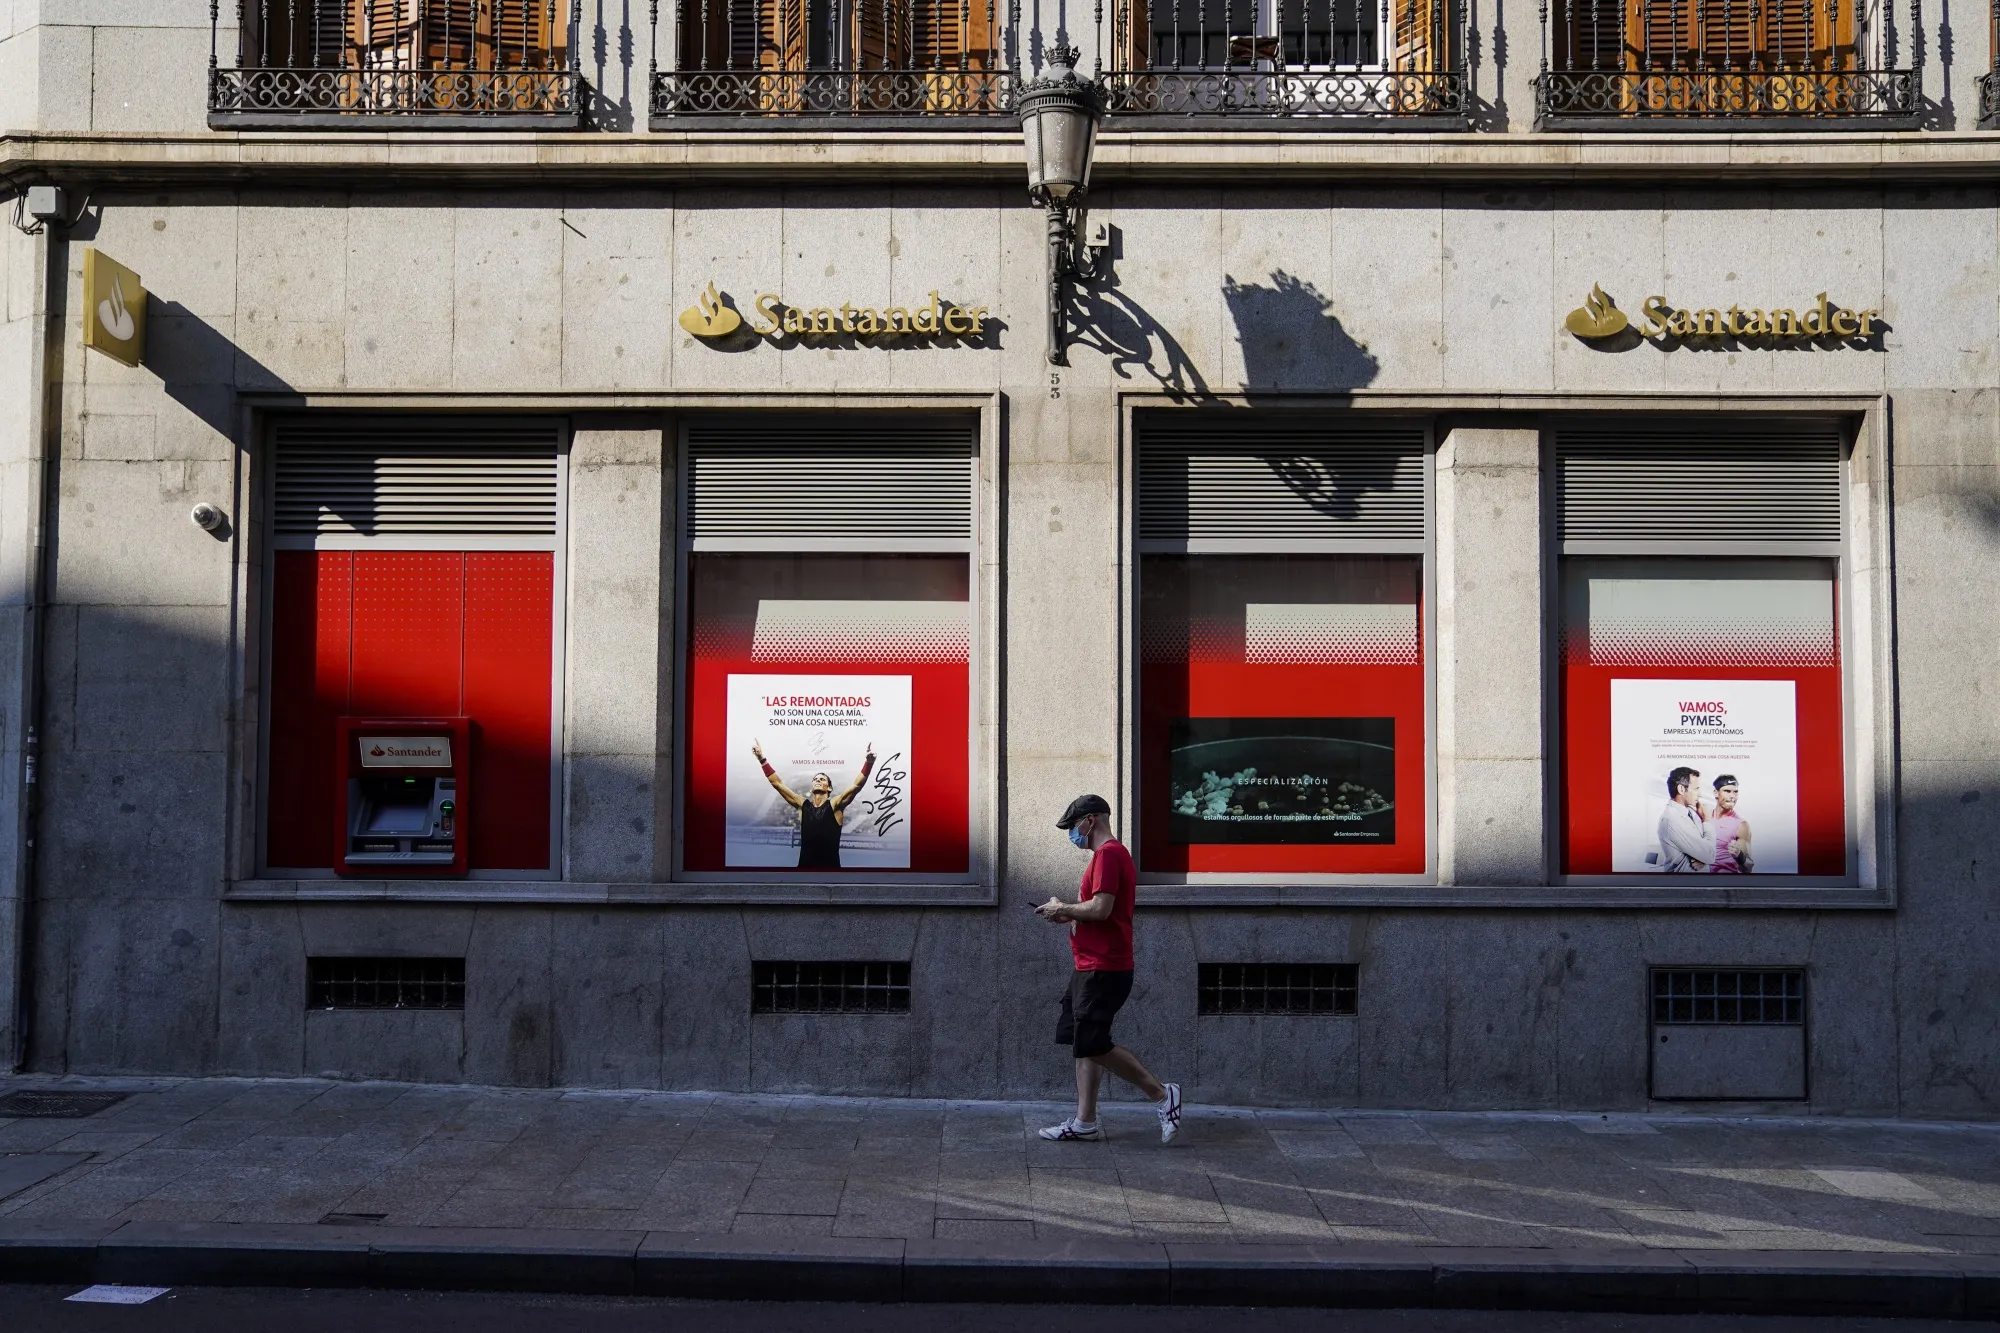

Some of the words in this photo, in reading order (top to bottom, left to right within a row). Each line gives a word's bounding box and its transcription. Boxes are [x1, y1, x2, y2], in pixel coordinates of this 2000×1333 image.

[754, 289, 989, 334] Santander
[1640, 291, 1880, 337] Santander
[789, 696, 871, 708] REMONTADAS
[773, 709, 786, 717] NO
[787, 709, 804, 717] SON
[805, 709, 822, 717] UNA
[823, 709, 845, 717] COSA
[845, 707, 864, 717] MÍA.
[1678, 701, 1728, 715] VAMOS,
[769, 718, 786, 727] SON
[787, 718, 805, 727] UNA
[805, 718, 827, 727] COSA
[1680, 714, 1726, 729] PYMES,
[1702, 727, 1744, 735] AUTÓNOMOS
[387, 746, 442, 757] Santander
[1238, 775, 1329, 786] ESPECIALIZACIÓN
[1203, 813, 1230, 821] estamos
[1230, 814, 1263, 822] orgullosos
[1295, 814, 1312, 822] parte
[1312, 813, 1321, 821] de
[1321, 813, 1336, 821] este
[1336, 813, 1363, 822] impulso.
